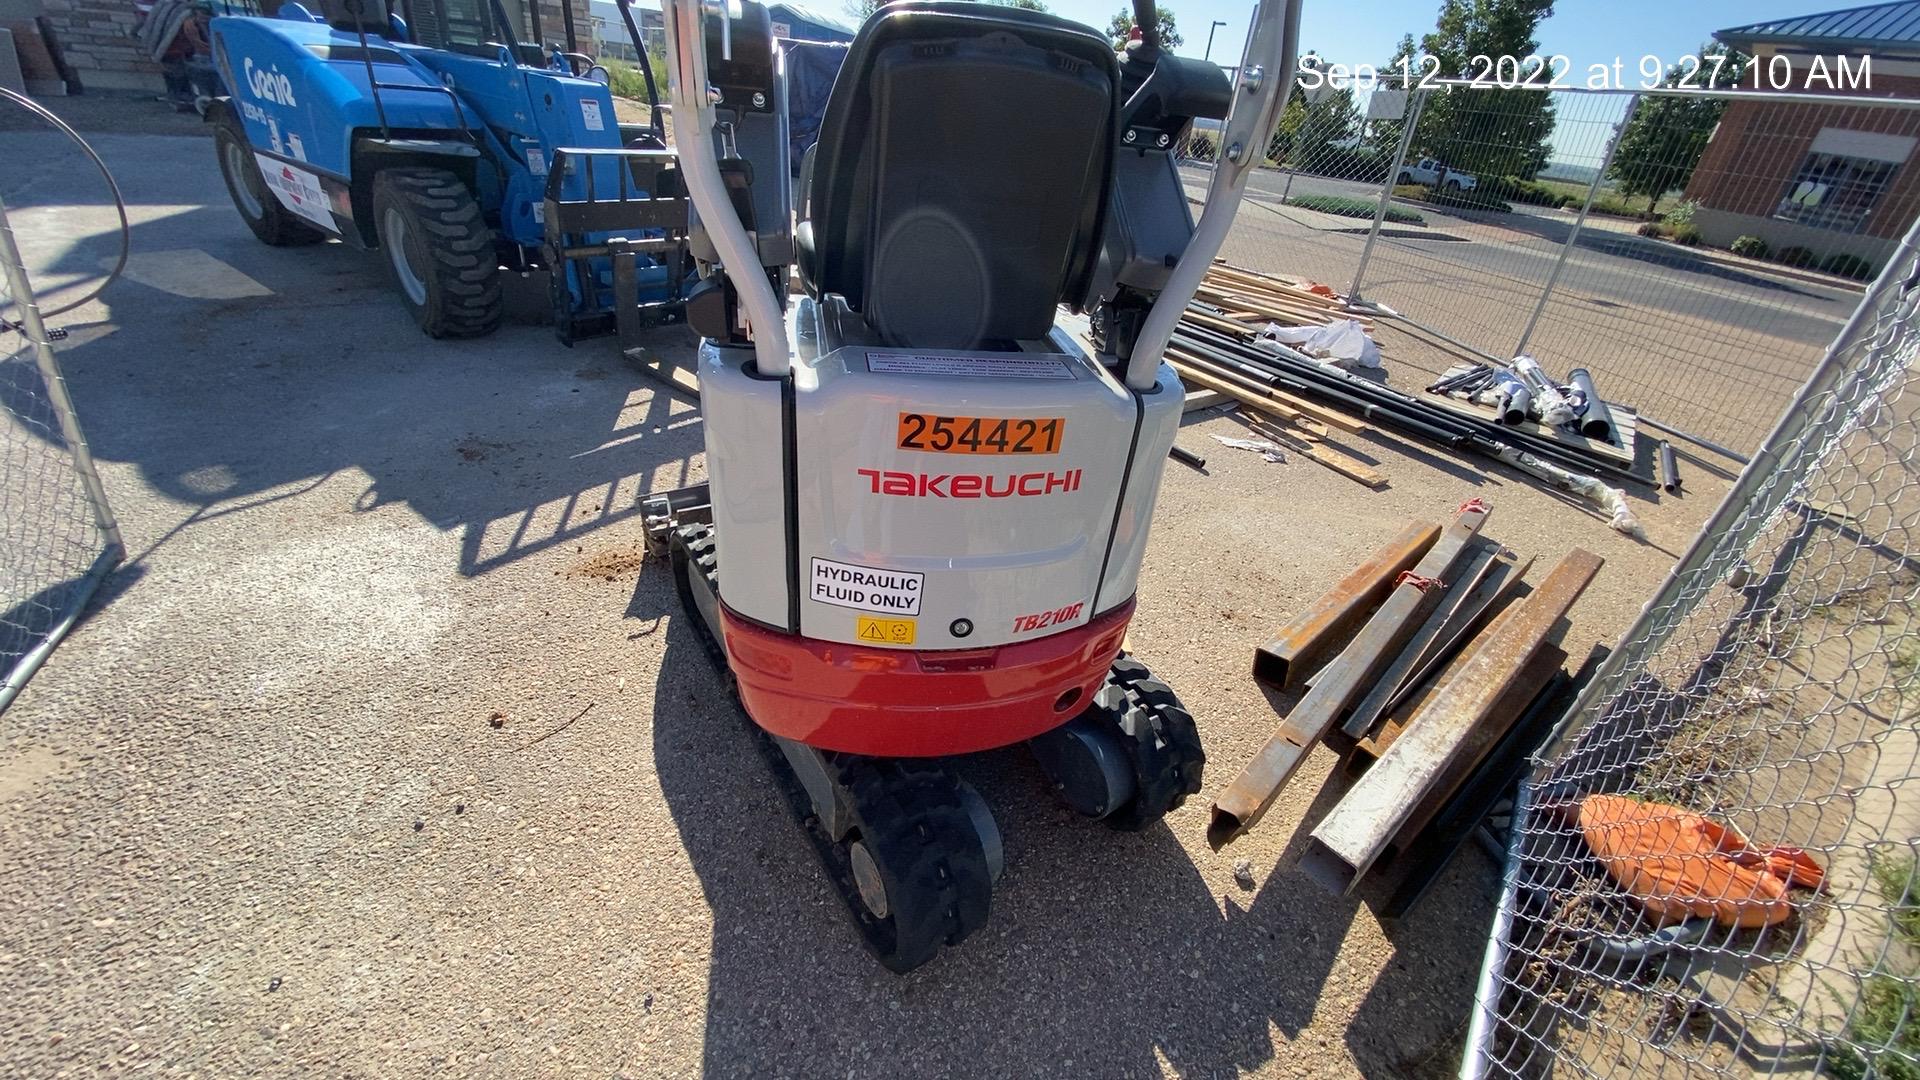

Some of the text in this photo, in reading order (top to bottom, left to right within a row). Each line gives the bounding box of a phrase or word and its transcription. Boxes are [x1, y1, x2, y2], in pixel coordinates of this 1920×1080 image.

[244, 57, 296, 107] Genie
[900, 413, 1058, 453] 254421
[857, 468, 1083, 499] TAKEUCHI
[816, 564, 918, 592] HYDRAULIC
[816, 583, 916, 610] FLUID ONLY
[1011, 602, 1084, 635] TB210R
